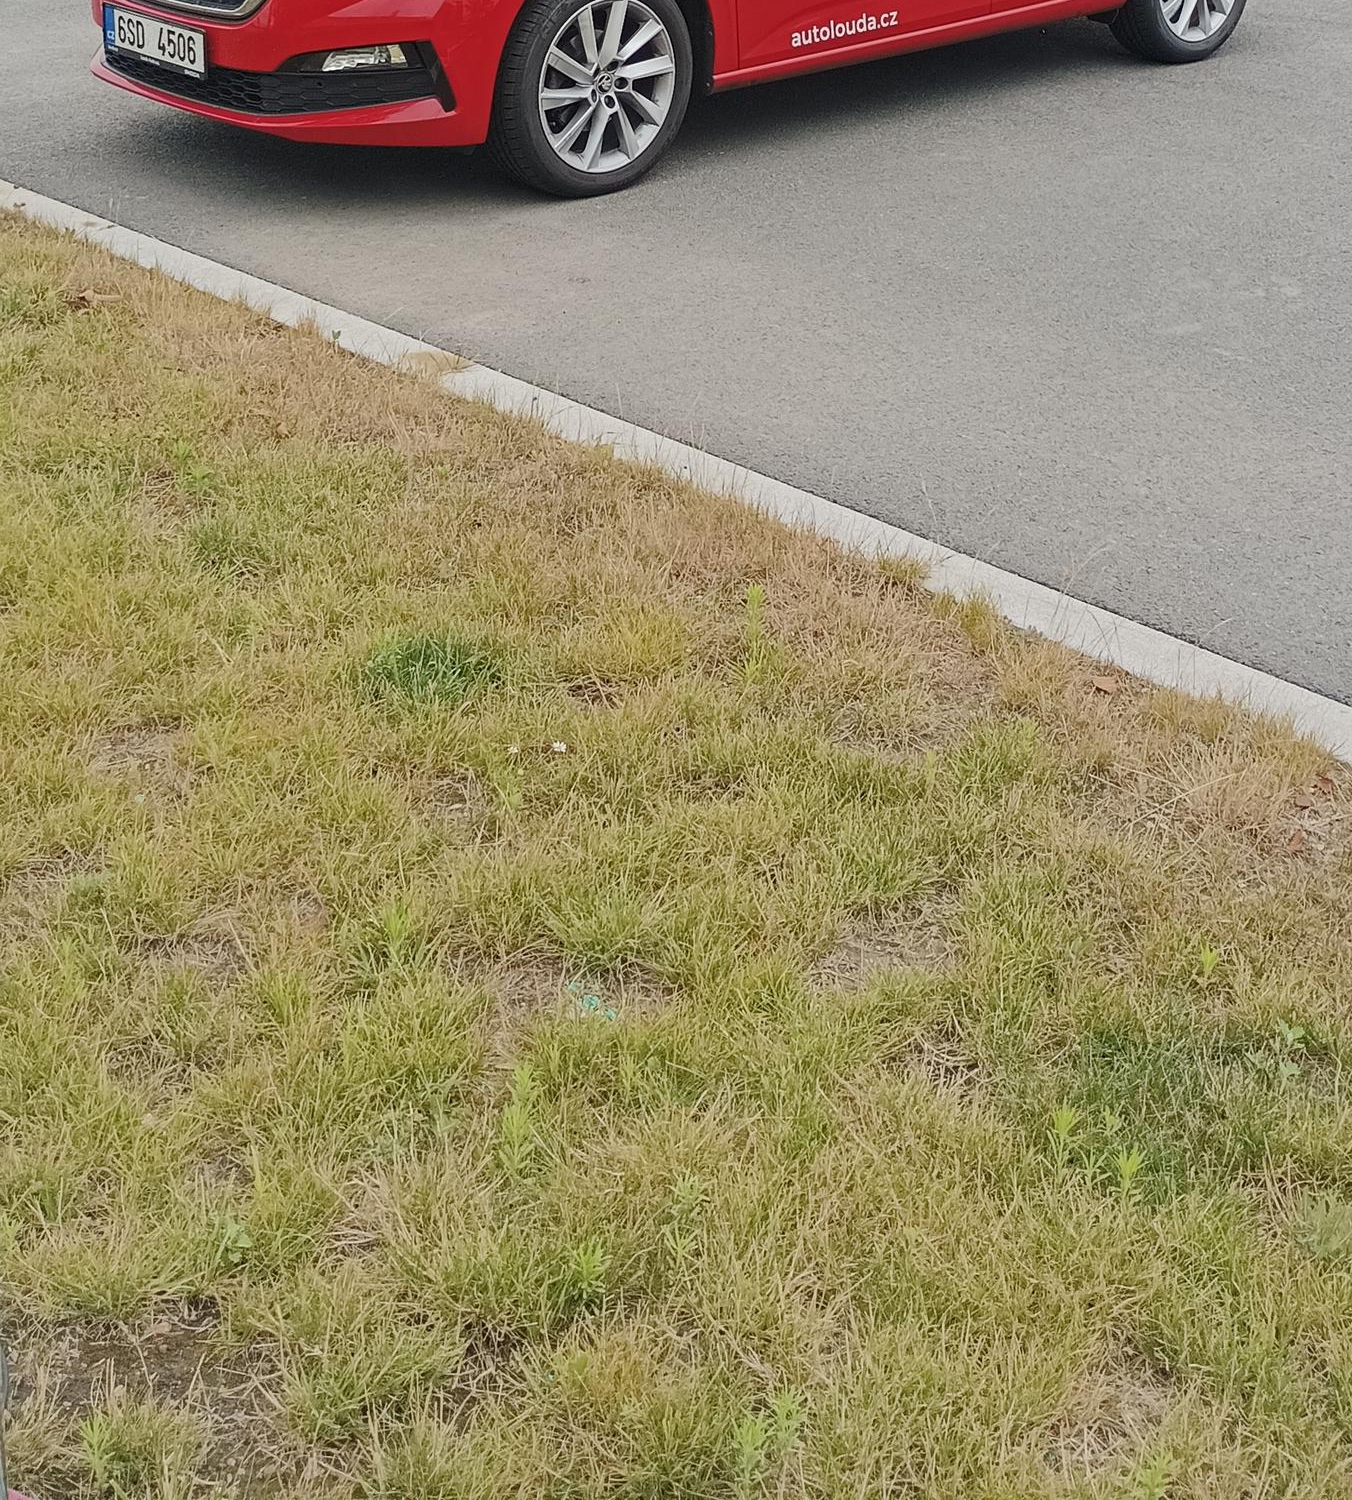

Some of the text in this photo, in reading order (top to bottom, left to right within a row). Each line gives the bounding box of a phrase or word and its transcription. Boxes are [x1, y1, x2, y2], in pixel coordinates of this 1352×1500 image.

[118, 16, 196, 65] 6SD 4506
[790, 10, 899, 48] autolouda.cz
